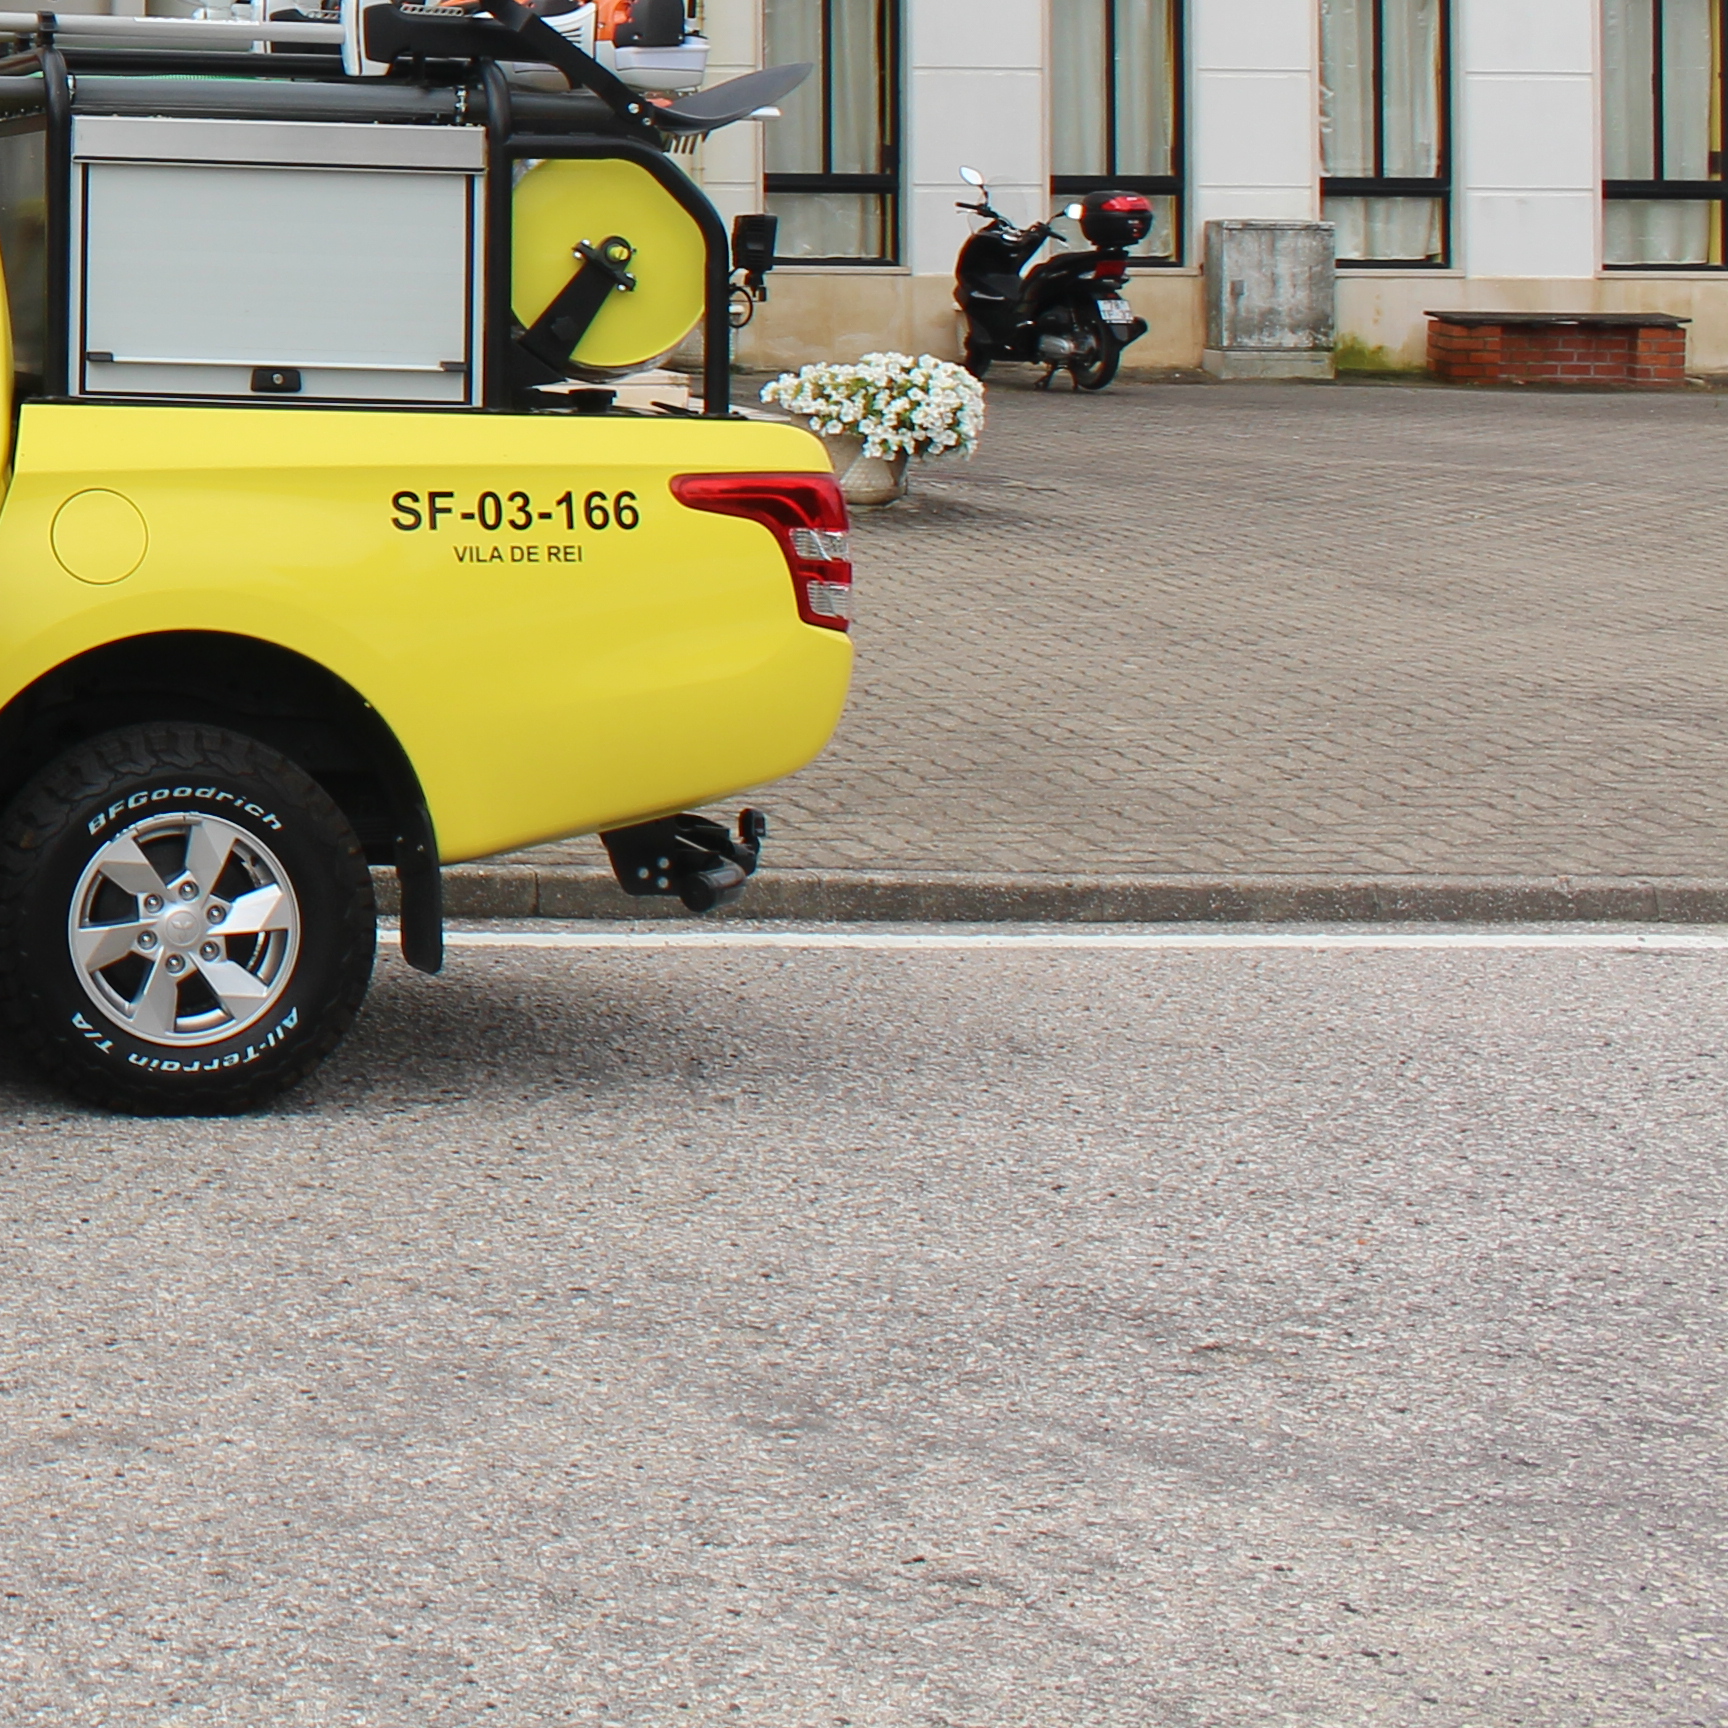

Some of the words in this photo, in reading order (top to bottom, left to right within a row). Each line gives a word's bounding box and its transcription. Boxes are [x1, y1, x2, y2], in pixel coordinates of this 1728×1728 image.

[391, 491, 639, 531] SF-03-166
[453, 546, 504, 563] VILA
[510, 546, 539, 563] DE
[547, 546, 583, 563] REI
[87, 786, 284, 837] BFGoodrich
[71, 1012, 116, 1055] T/A
[128, 1006, 300, 1073] All-Terrain
